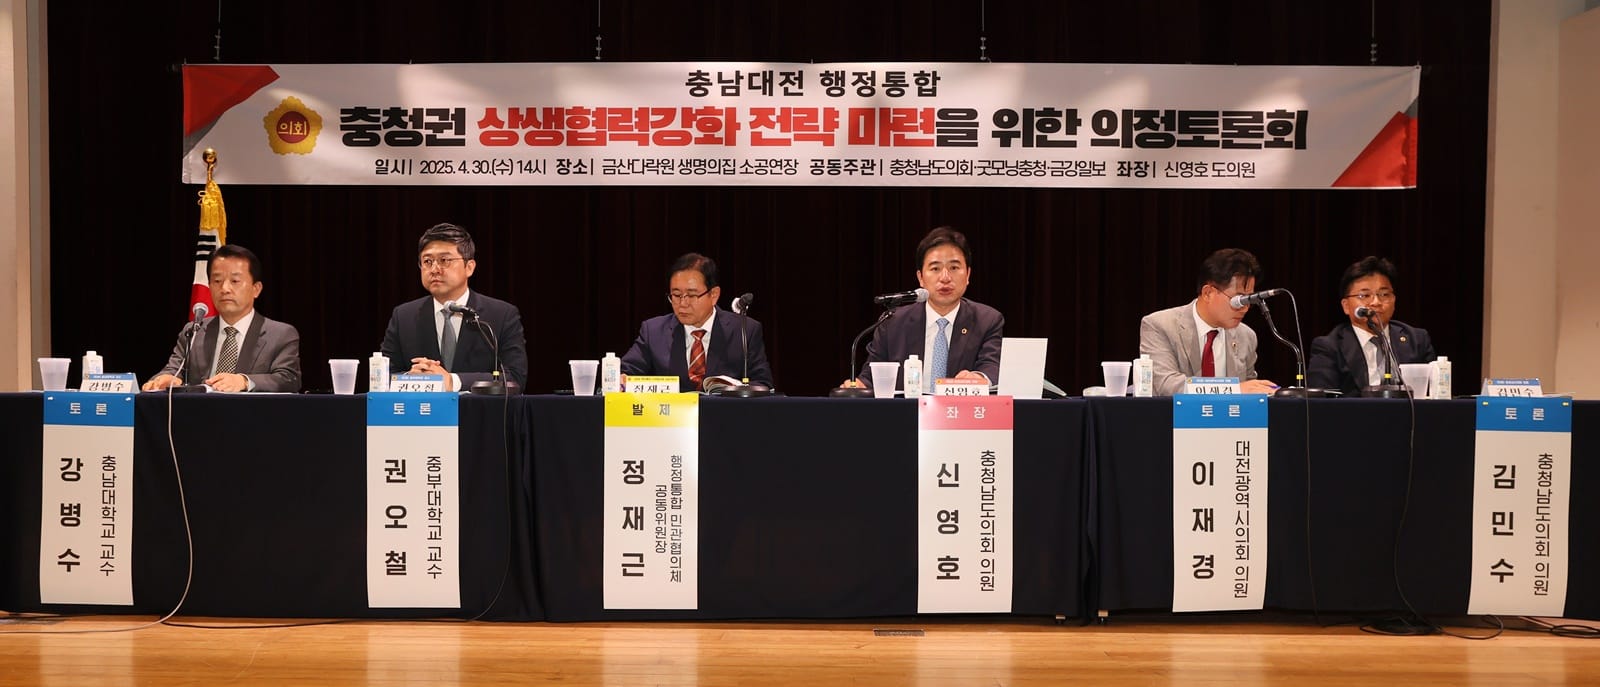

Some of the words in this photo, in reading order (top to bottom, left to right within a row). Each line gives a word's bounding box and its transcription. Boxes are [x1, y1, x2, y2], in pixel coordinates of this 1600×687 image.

[685, 70, 804, 97] 충남대전
[819, 70, 941, 98] 행정통합
[278, 119, 308, 137] 의회
[339, 106, 466, 147] 충청권
[477, 106, 741, 147] 상생협력강화
[749, 106, 839, 147] 전략
[847, 106, 979, 147] 마련을
[991, 107, 1082, 149] 위한
[1090, 109, 1309, 150] 의정토론회
[517, 159, 546, 175] 14시
[602, 158, 675, 175] 금산다락원
[678, 158, 736, 175] 생명의집
[739, 158, 799, 175] 소공연장
[1164, 161, 1208, 178] 신영호
[1211, 162, 1255, 178] 도의원
[70, 402, 107, 415] 토론
[393, 402, 431, 415] 토론
[632, 403, 671, 416] 발제
[946, 406, 986, 419] 좌장
[1201, 404, 1240, 417] 토론
[1505, 407, 1544, 421] 토론
[100, 455, 117, 538] 충남대학교
[427, 456, 443, 540] 중부대학교
[670, 455, 683, 510] 행정통합
[980, 450, 996, 553] 충청남도의회
[1235, 440, 1251, 561] 대전광역시의회
[57, 457, 83, 572] 강병수
[384, 459, 408, 576] 권오철
[621, 460, 645, 577] 정재근
[655, 484, 667, 554] 공동위원장
[936, 463, 960, 580] 신영호
[1192, 461, 1215, 579] 이재경
[1490, 464, 1516, 583] 김민수
[1535, 453, 1553, 557] 충청남도의회
[100, 544, 115, 576] 교수
[427, 547, 442, 579] 교수
[670, 514, 682, 583] 민관협의체
[980, 558, 995, 592] 의원
[1234, 566, 1249, 599] 의원
[1534, 562, 1549, 596] 의원
